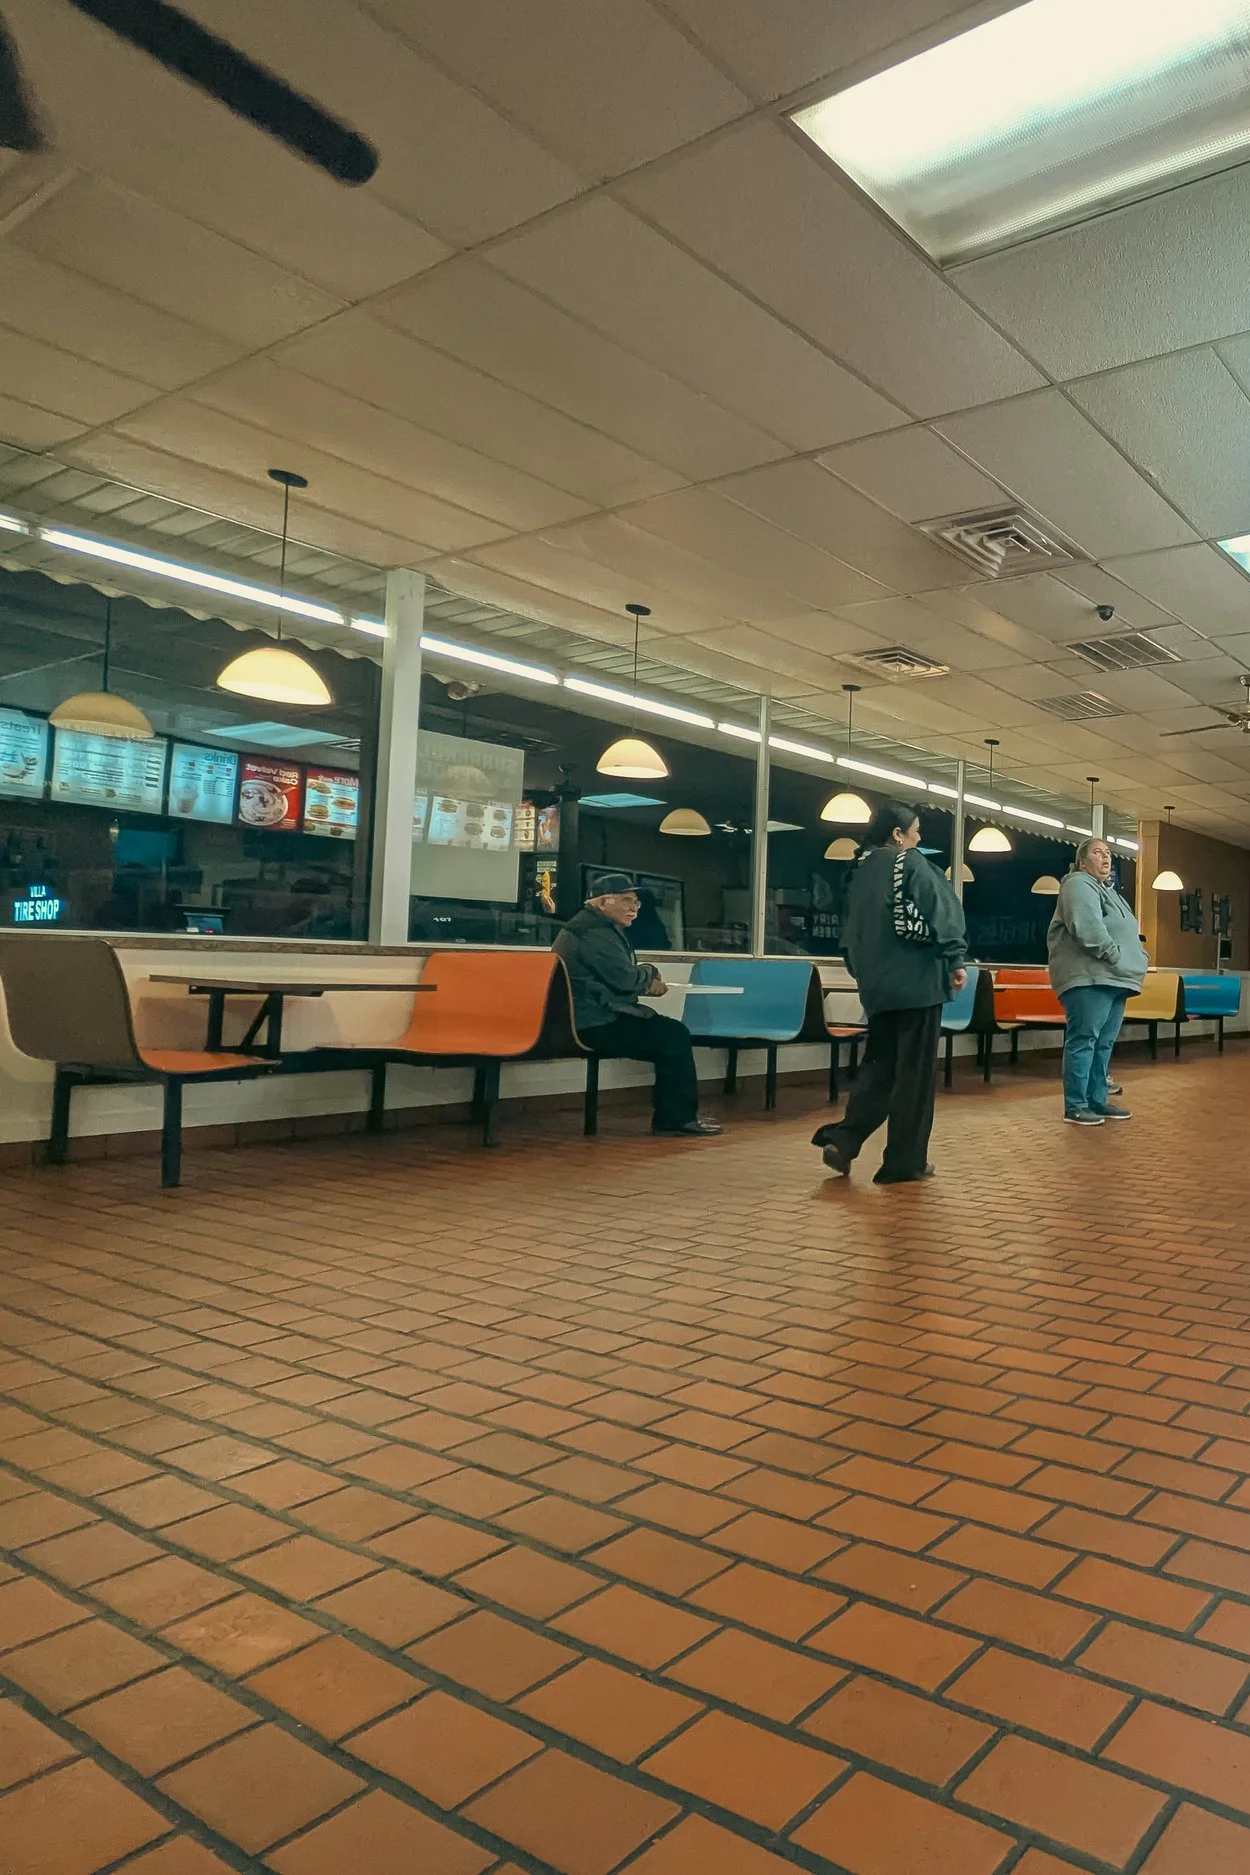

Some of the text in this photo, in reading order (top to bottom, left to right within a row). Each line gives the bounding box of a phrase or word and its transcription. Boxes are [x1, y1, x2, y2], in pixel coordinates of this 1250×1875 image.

[30, 885, 46, 898] VILLA
[14, 899, 60, 921] TIRE SHOP
